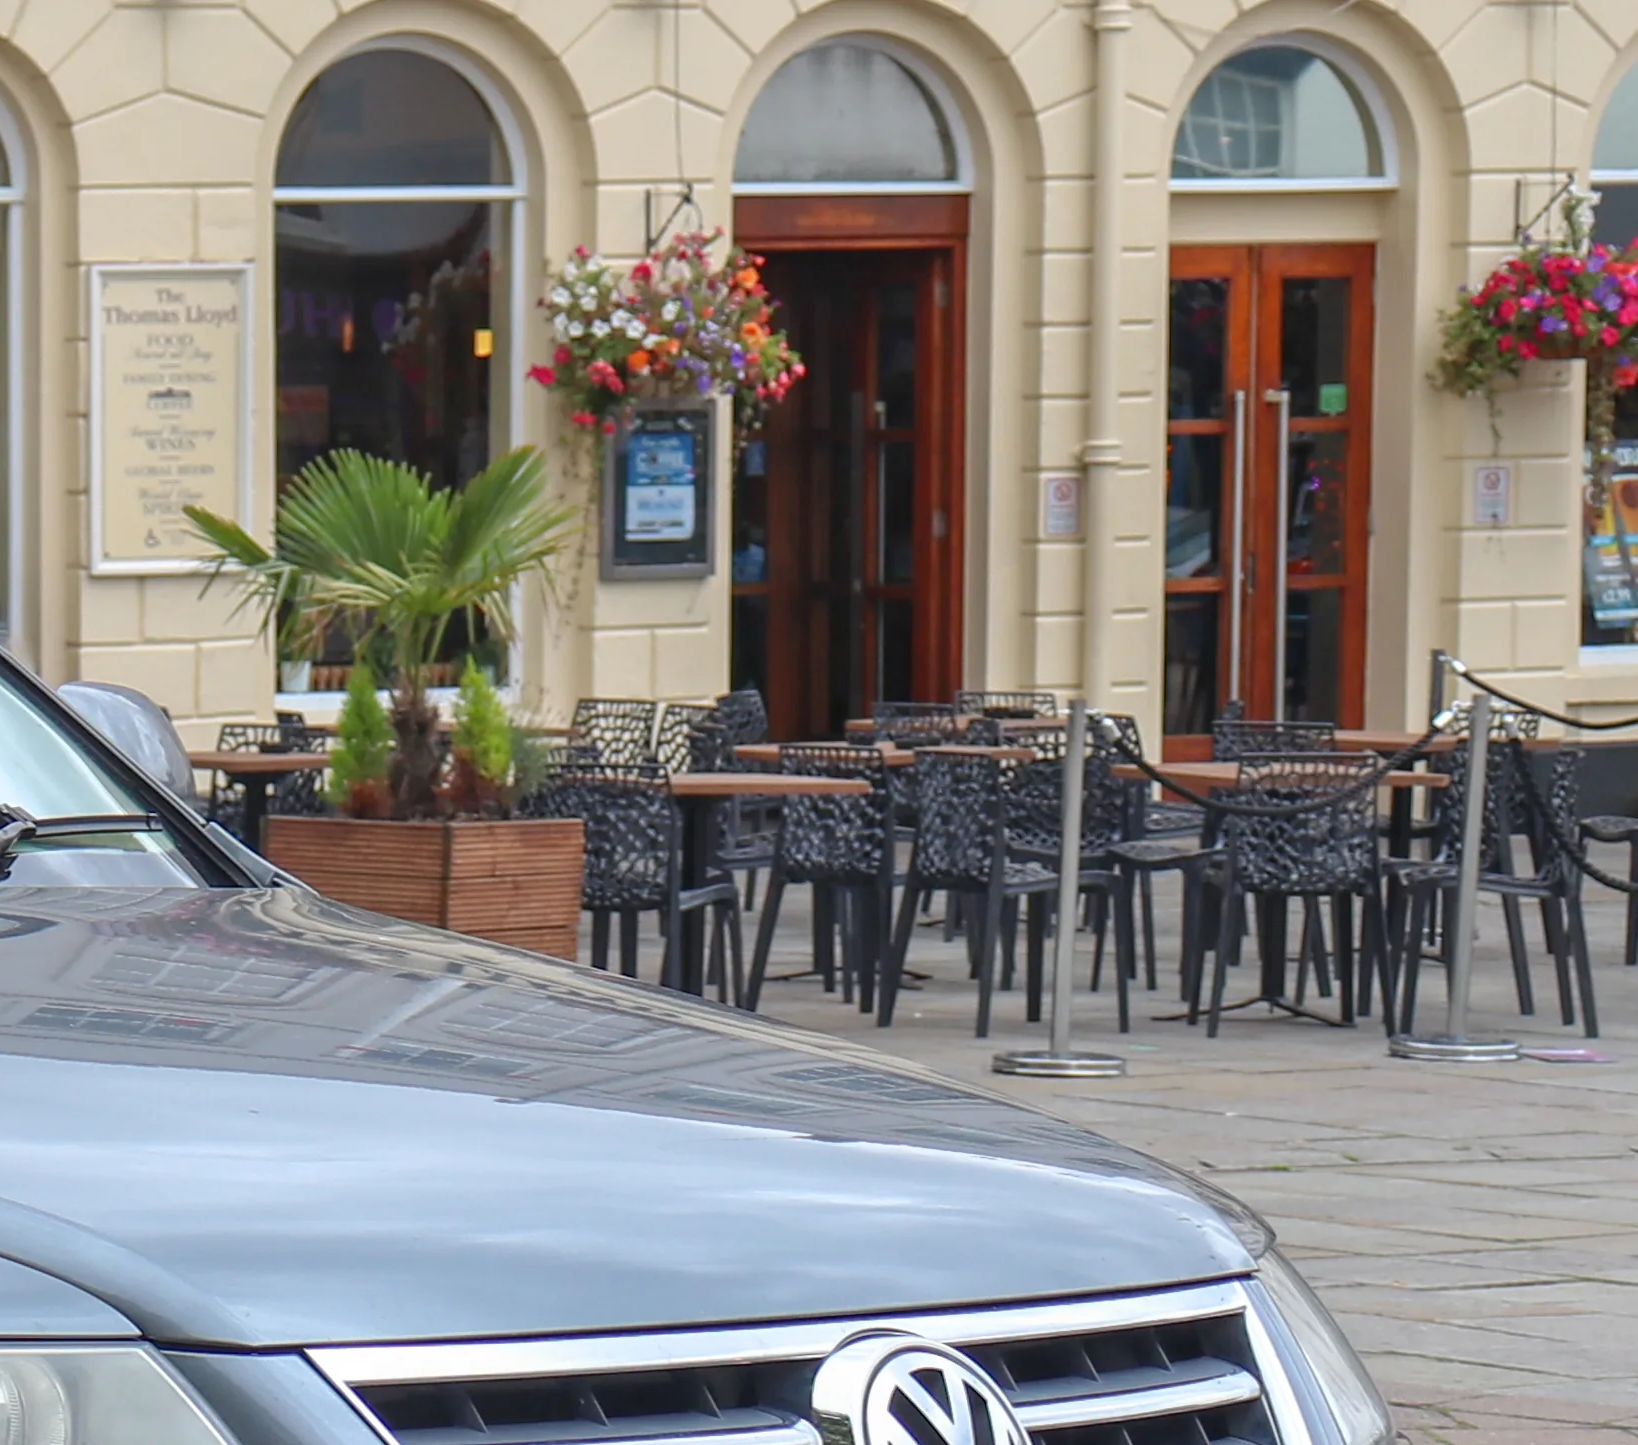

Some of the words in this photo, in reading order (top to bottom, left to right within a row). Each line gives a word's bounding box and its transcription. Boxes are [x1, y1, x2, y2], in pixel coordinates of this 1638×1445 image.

[154, 288, 185, 303] The
[103, 304, 179, 325] Thomas
[186, 304, 237, 328] Lloyd
[147, 333, 194, 347] FOOD
